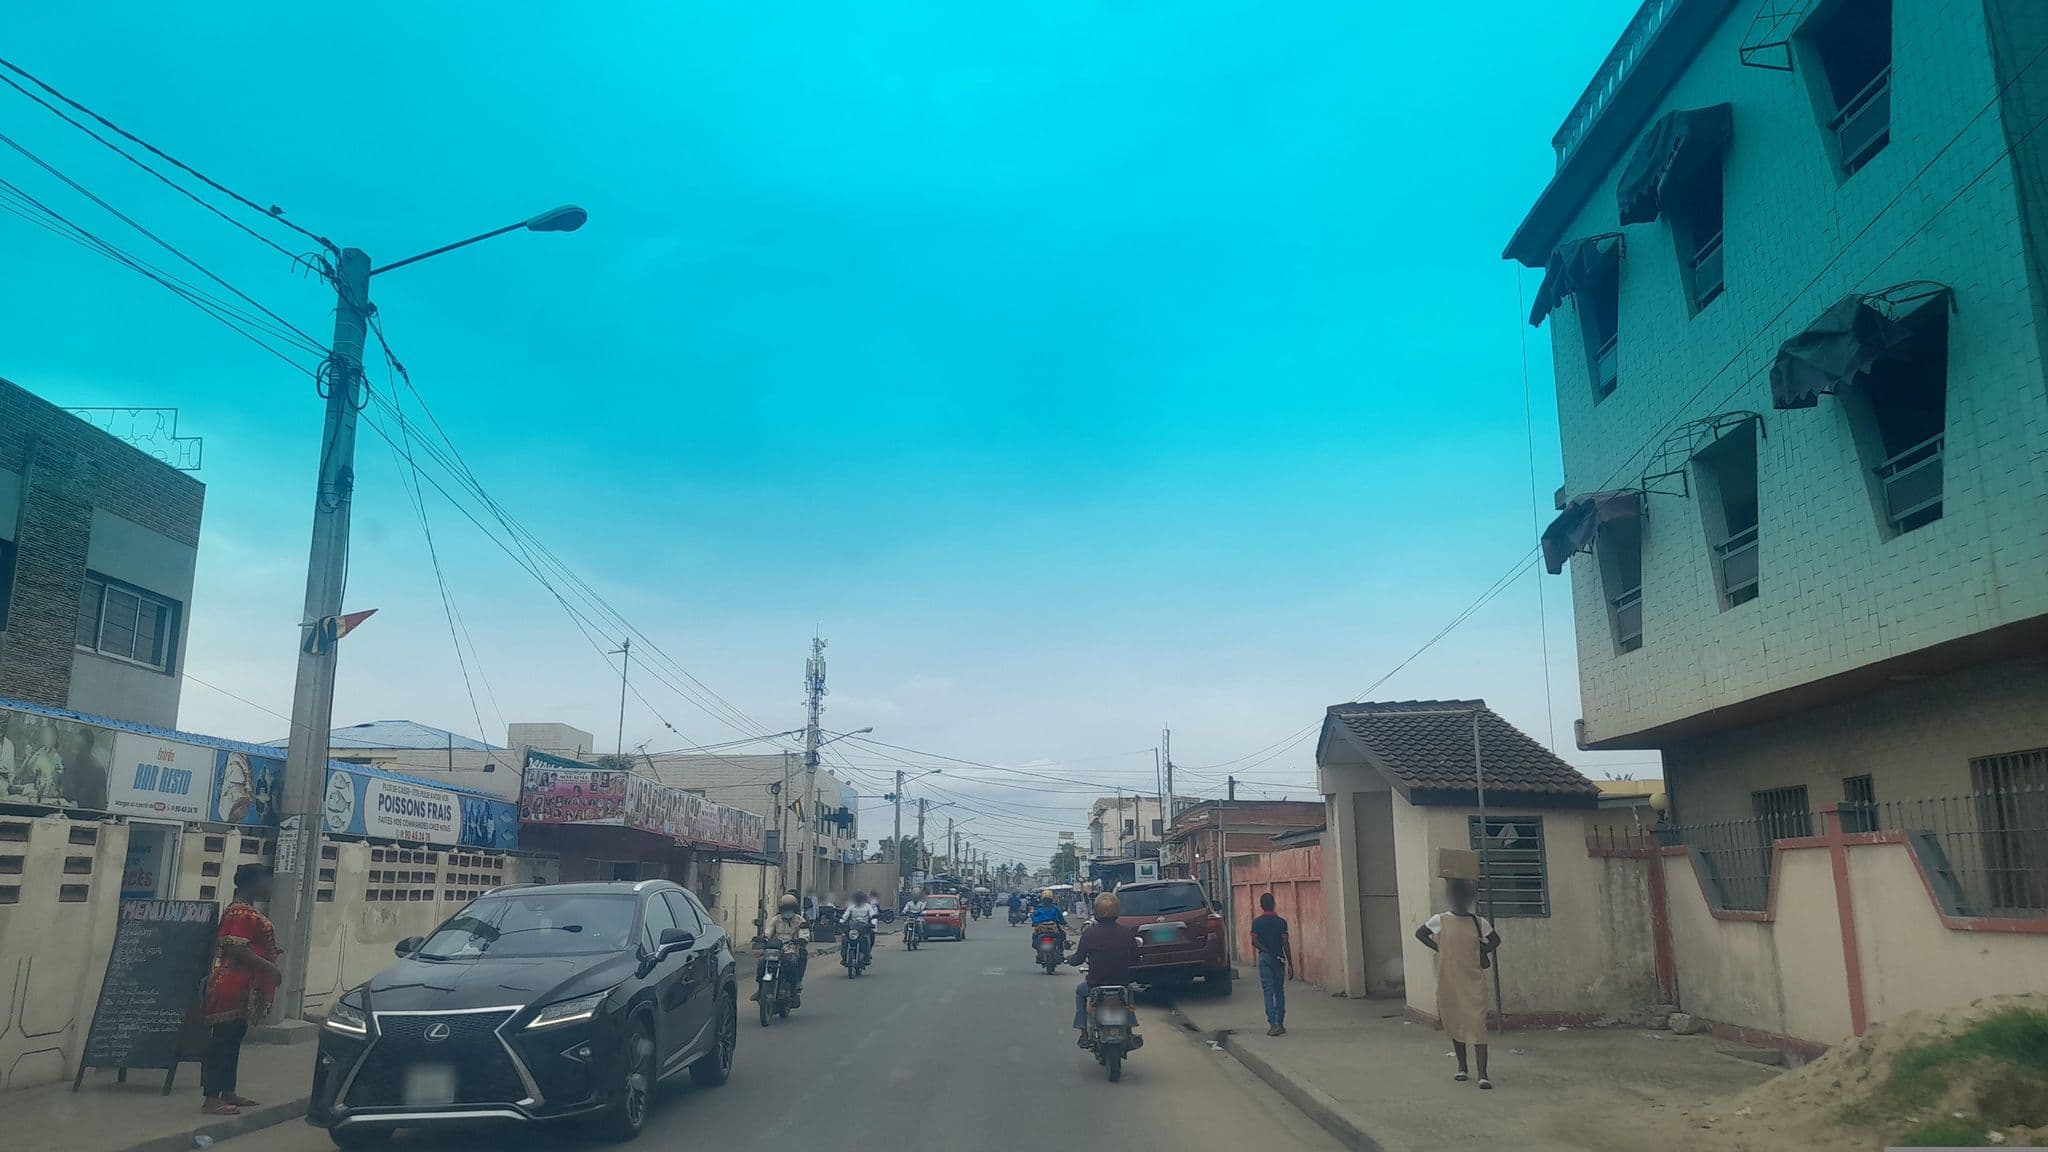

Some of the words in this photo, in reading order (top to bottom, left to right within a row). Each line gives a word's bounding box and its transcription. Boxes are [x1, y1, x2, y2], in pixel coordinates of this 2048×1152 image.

[133, 763, 160, 791] BAR
[158, 767, 192, 795] RESTO
[378, 792, 426, 819] POISSONS
[427, 801, 452, 821] FRAIS
[122, 900, 165, 921] MENU
[164, 901, 184, 921] DU
